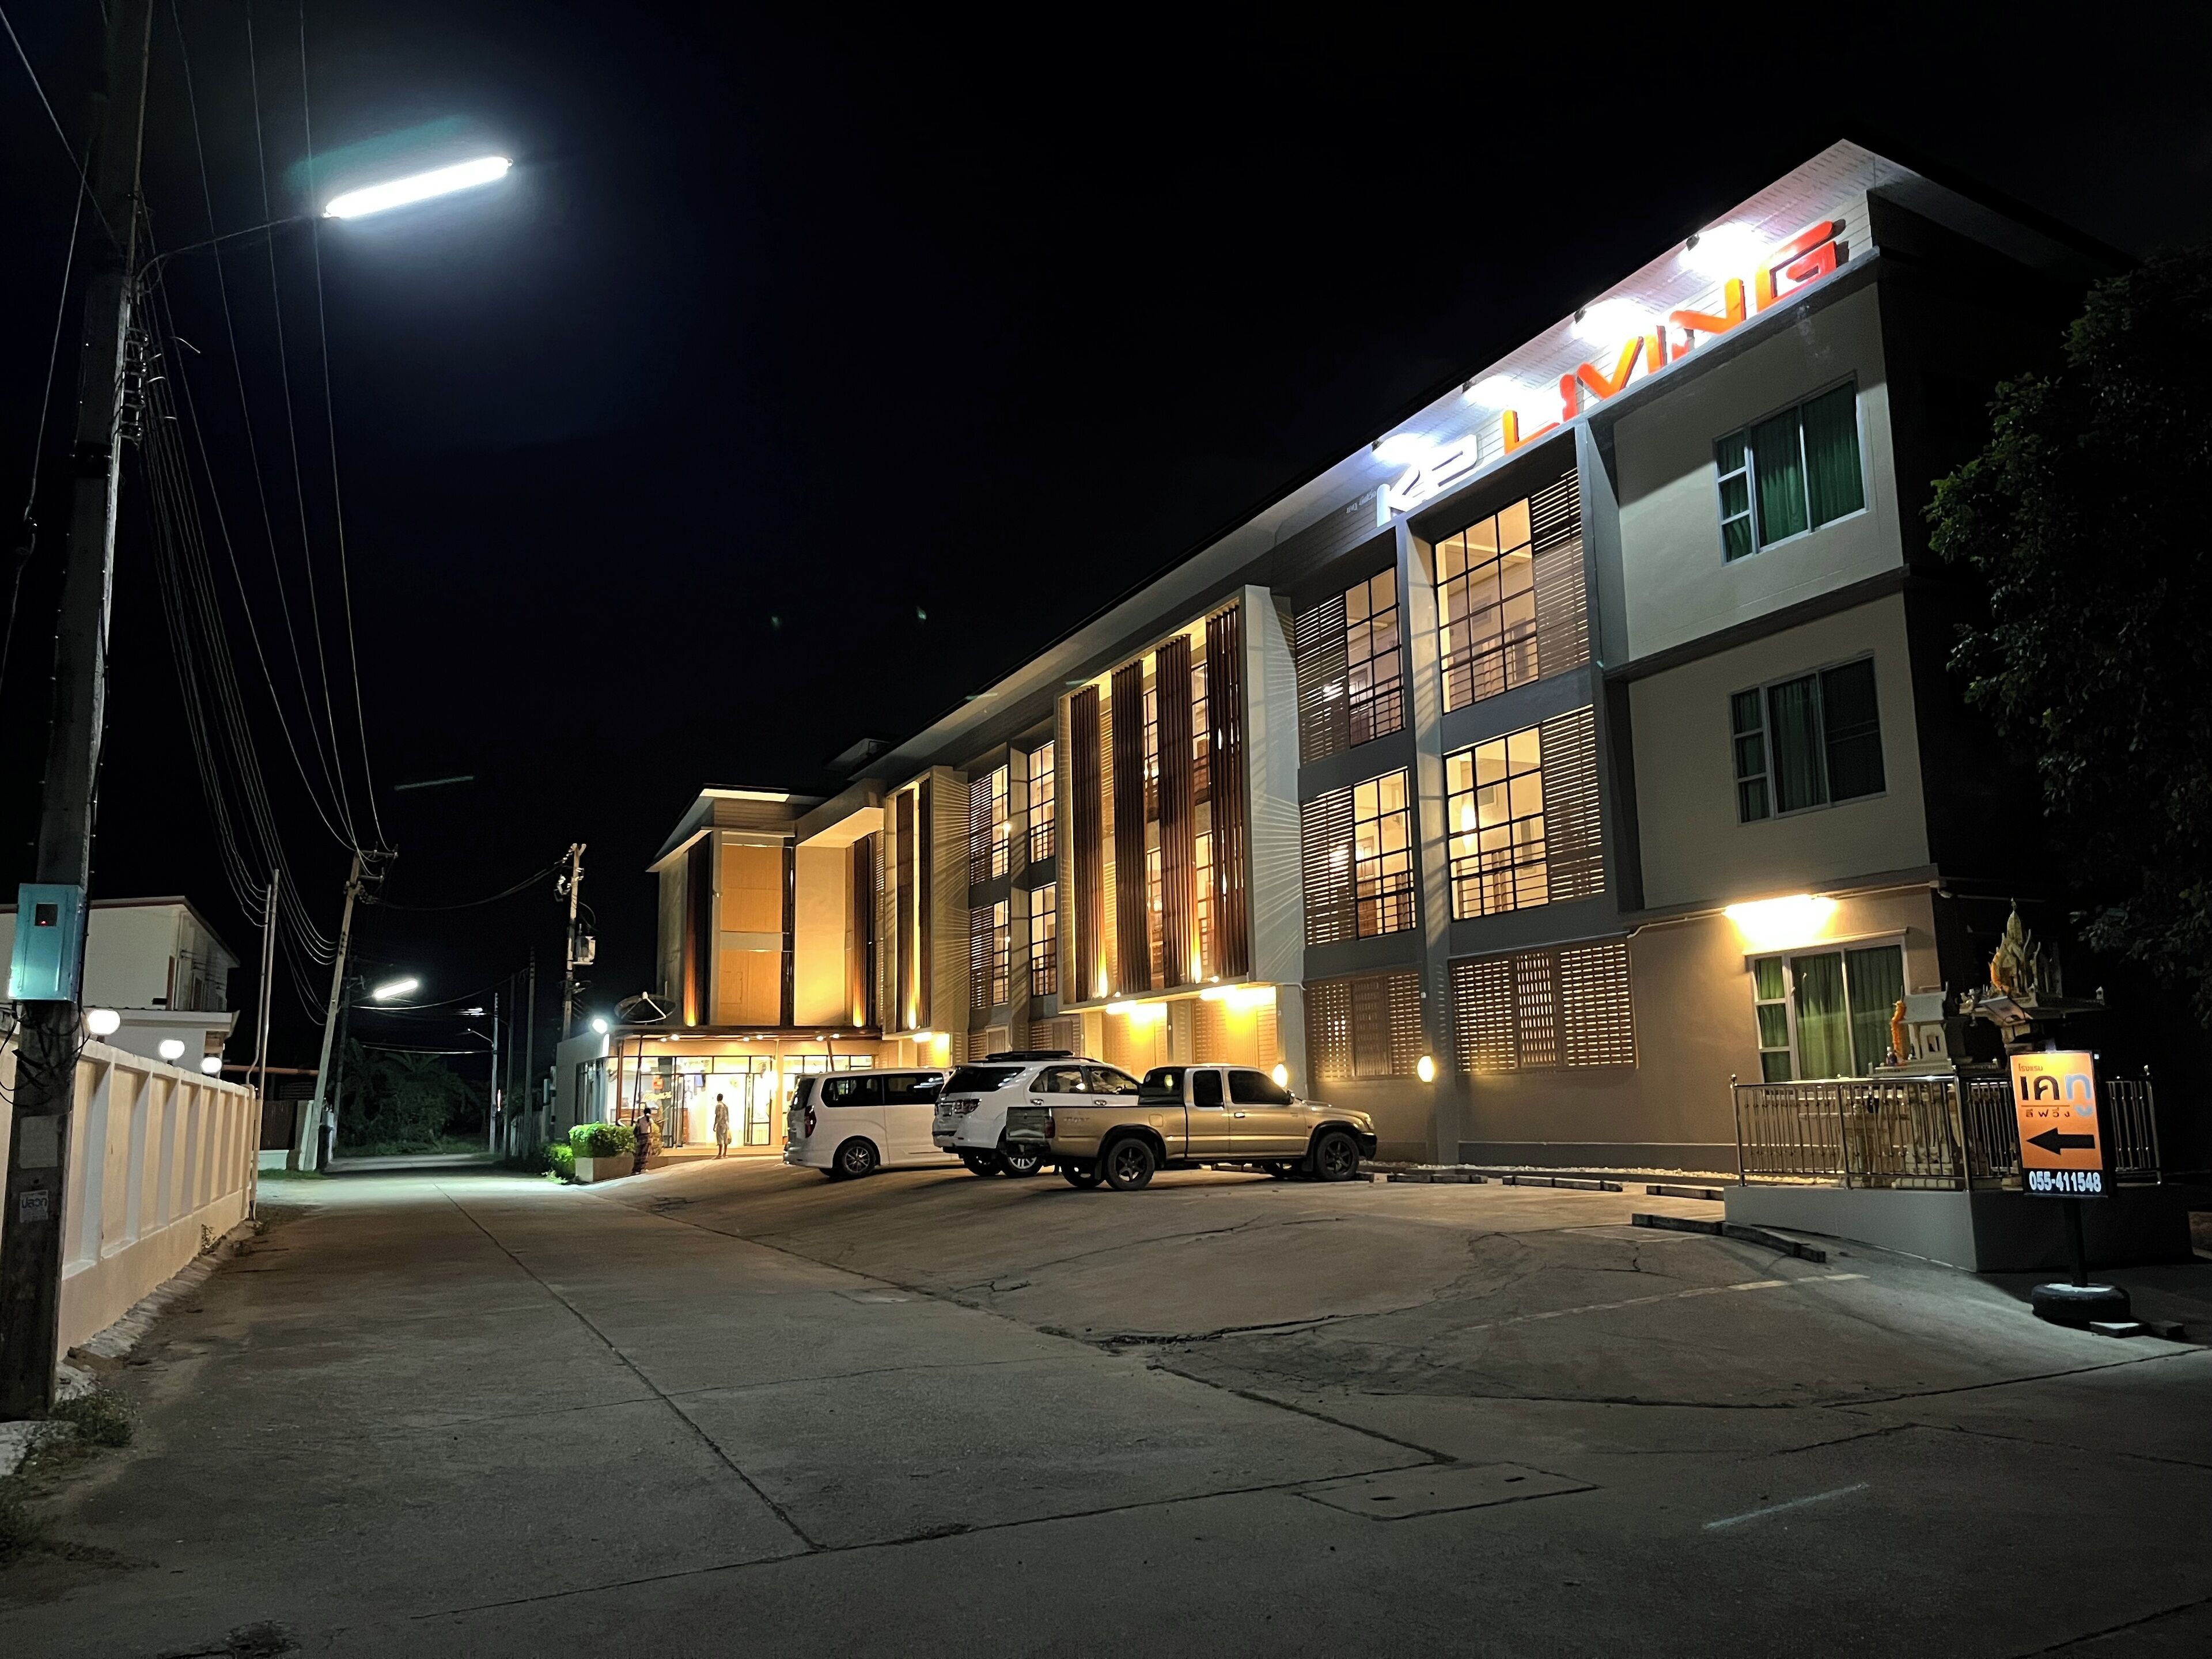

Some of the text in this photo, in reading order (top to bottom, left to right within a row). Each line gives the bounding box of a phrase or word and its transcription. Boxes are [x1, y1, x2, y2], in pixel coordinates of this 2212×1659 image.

[1376, 221, 1838, 528] K2 LIVING
[2018, 1063, 2043, 1071] โรงแรม
[2029, 1171, 2101, 1192] 055-411548
